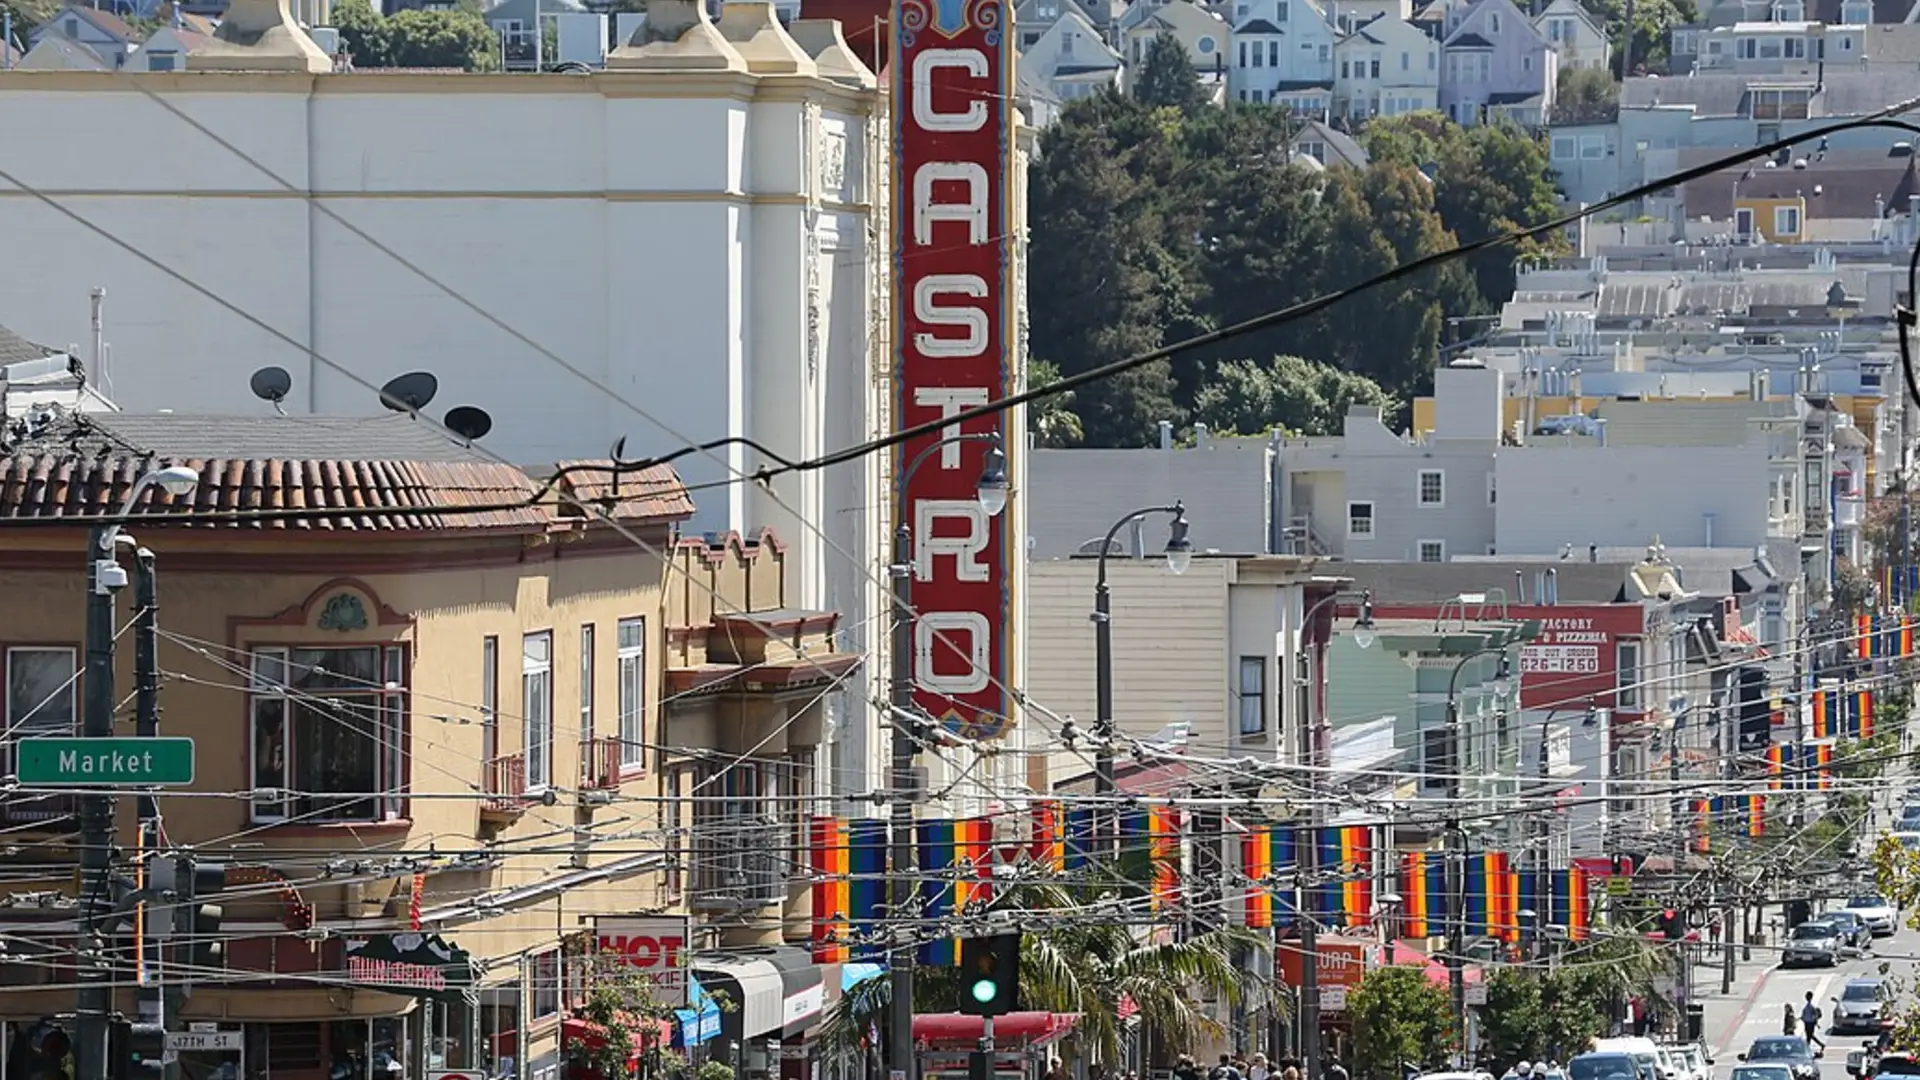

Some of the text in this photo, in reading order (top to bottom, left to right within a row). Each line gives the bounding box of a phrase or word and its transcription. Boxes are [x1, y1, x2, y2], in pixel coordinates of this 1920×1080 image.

[912, 48, 990, 694] CASTRO
[1541, 618, 1593, 630] FACTORY
[1556, 632, 1607, 643] PIZZERIA
[1521, 658, 1596, 671] 626-1250
[58, 750, 153, 773] Market
[599, 935, 683, 968] HOT
[214, 1036, 229, 1047] ST
